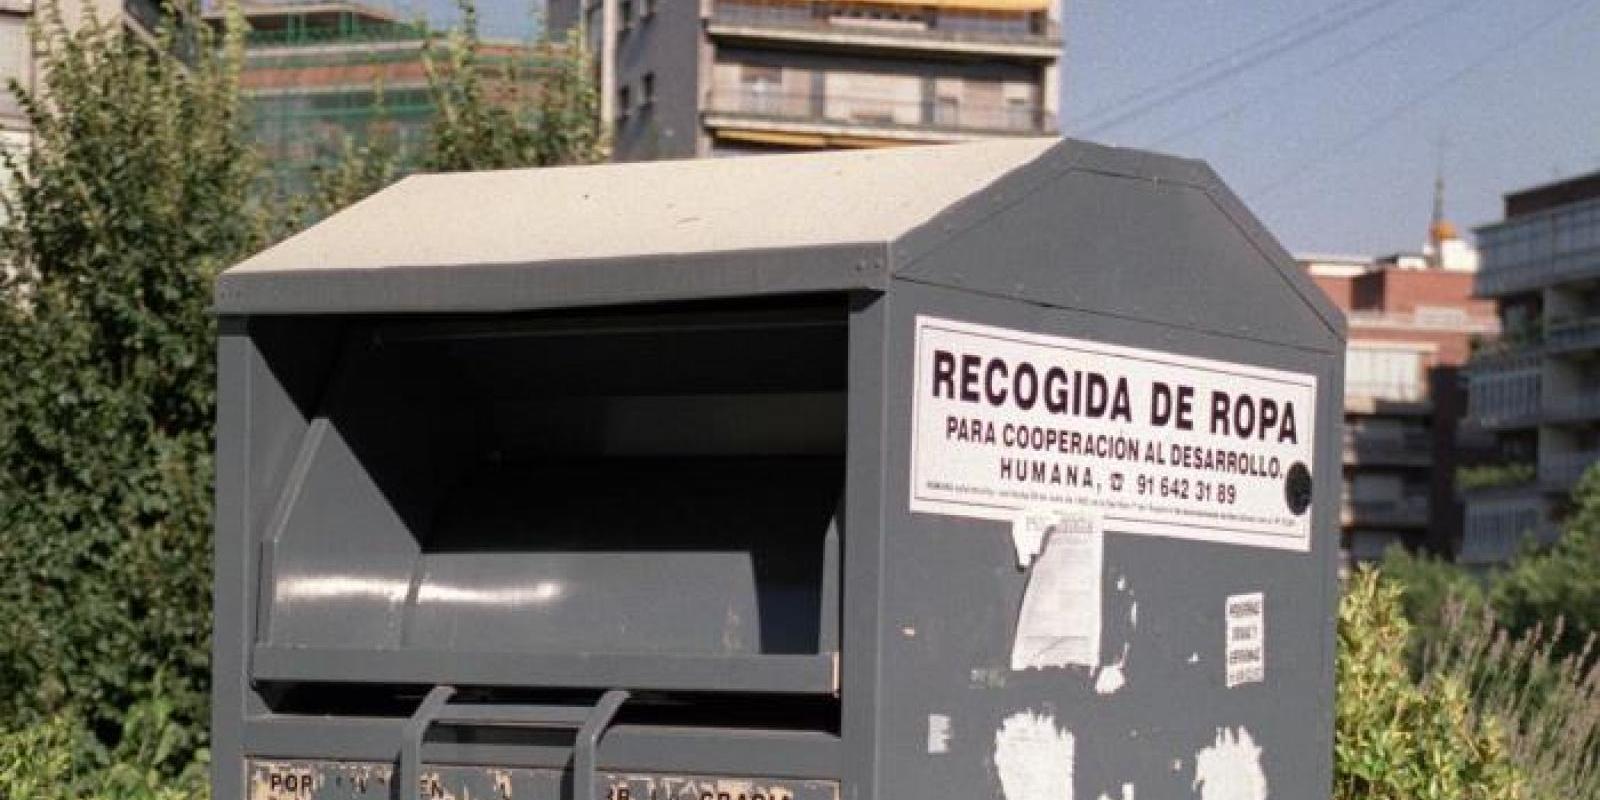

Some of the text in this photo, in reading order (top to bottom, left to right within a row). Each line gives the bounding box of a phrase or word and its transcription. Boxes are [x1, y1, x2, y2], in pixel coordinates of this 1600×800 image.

[932, 350, 1298, 444] RECOGIDA DE ROPA
[946, 416, 996, 444] PARA
[1145, 440, 1166, 465] AL
[1170, 443, 1283, 478] DESARROLLO.
[1137, 473, 1153, 496] 91
[1160, 475, 1190, 500] 642
[1195, 479, 1212, 501] 31
[1217, 482, 1237, 504] 89
